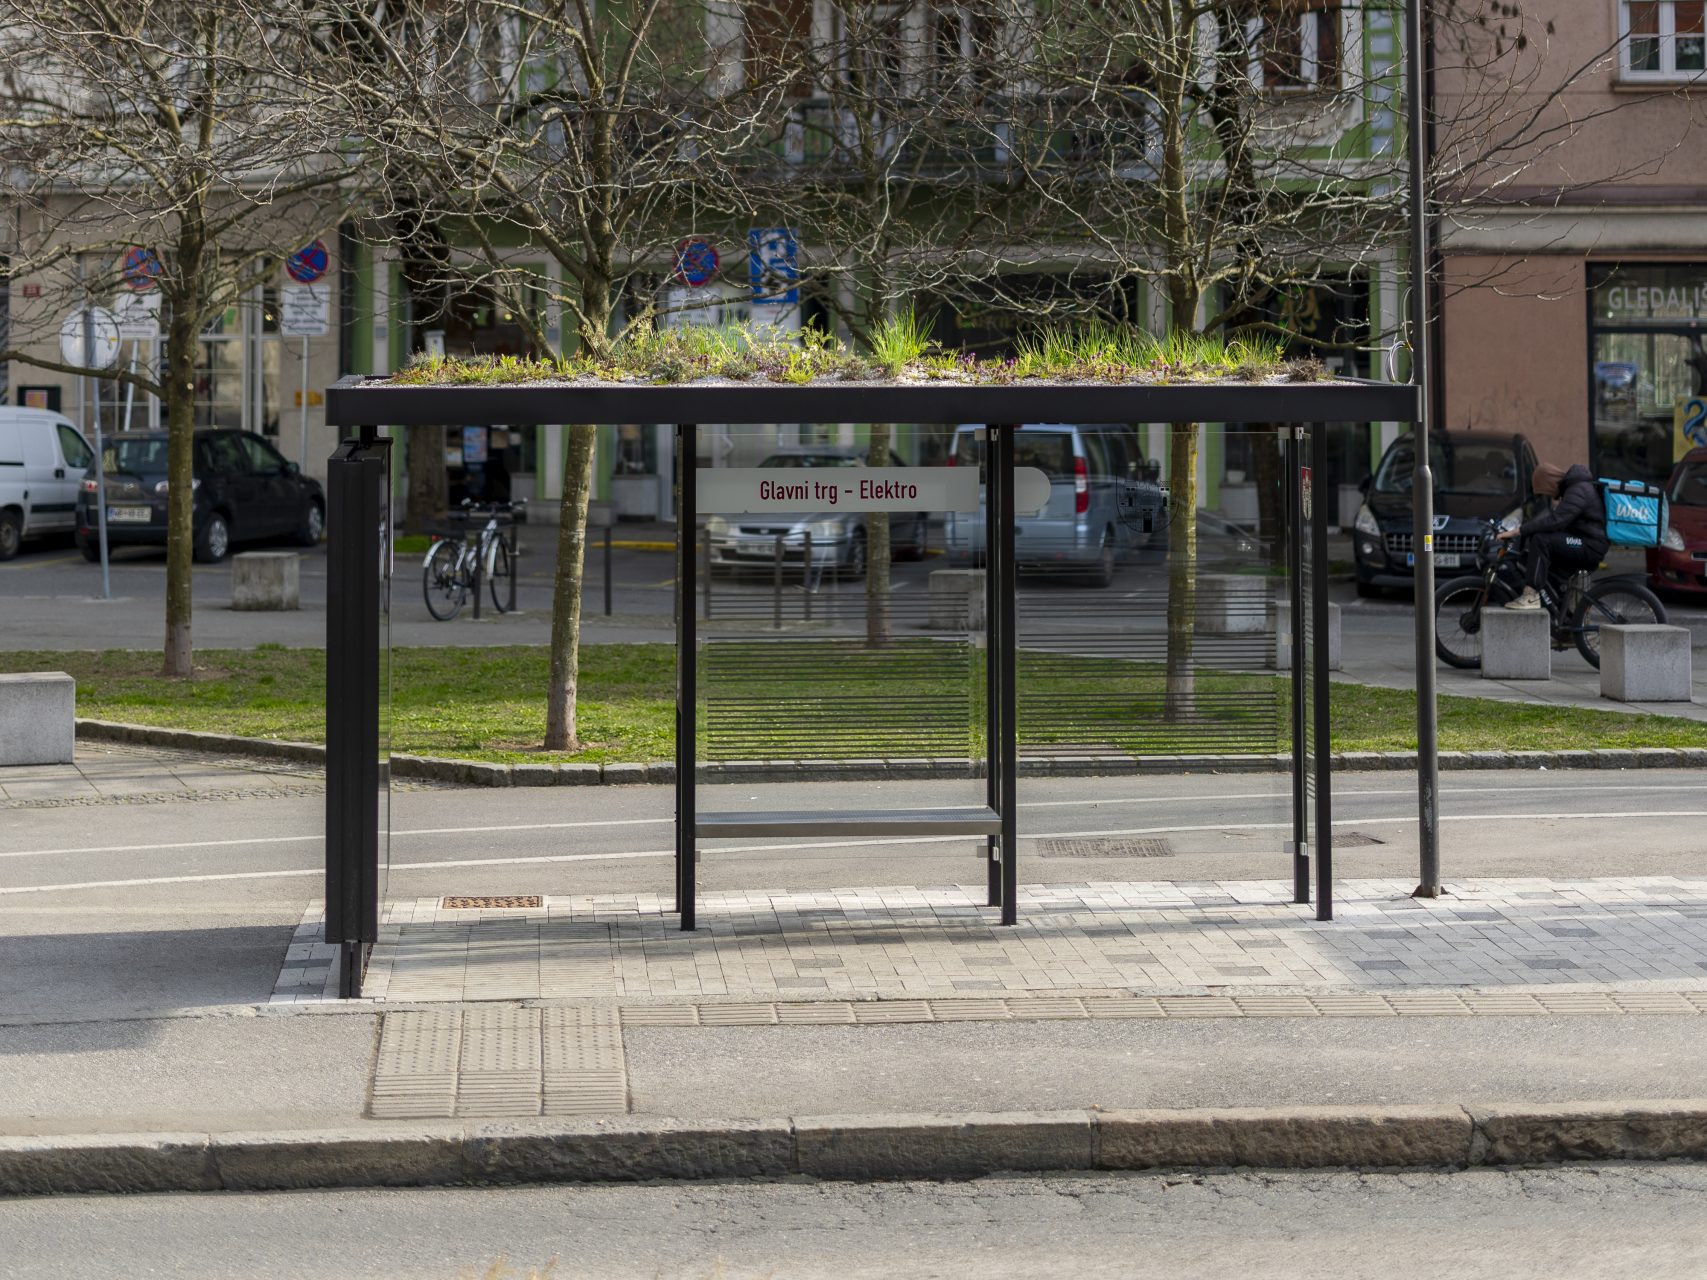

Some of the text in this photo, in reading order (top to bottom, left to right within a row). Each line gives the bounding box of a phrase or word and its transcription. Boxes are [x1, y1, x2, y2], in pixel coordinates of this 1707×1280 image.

[760, 480, 809, 500] Glavni
[814, 481, 838, 505] trg
[860, 480, 917, 499] Elektro
[1616, 503, 1649, 520] Wolt
